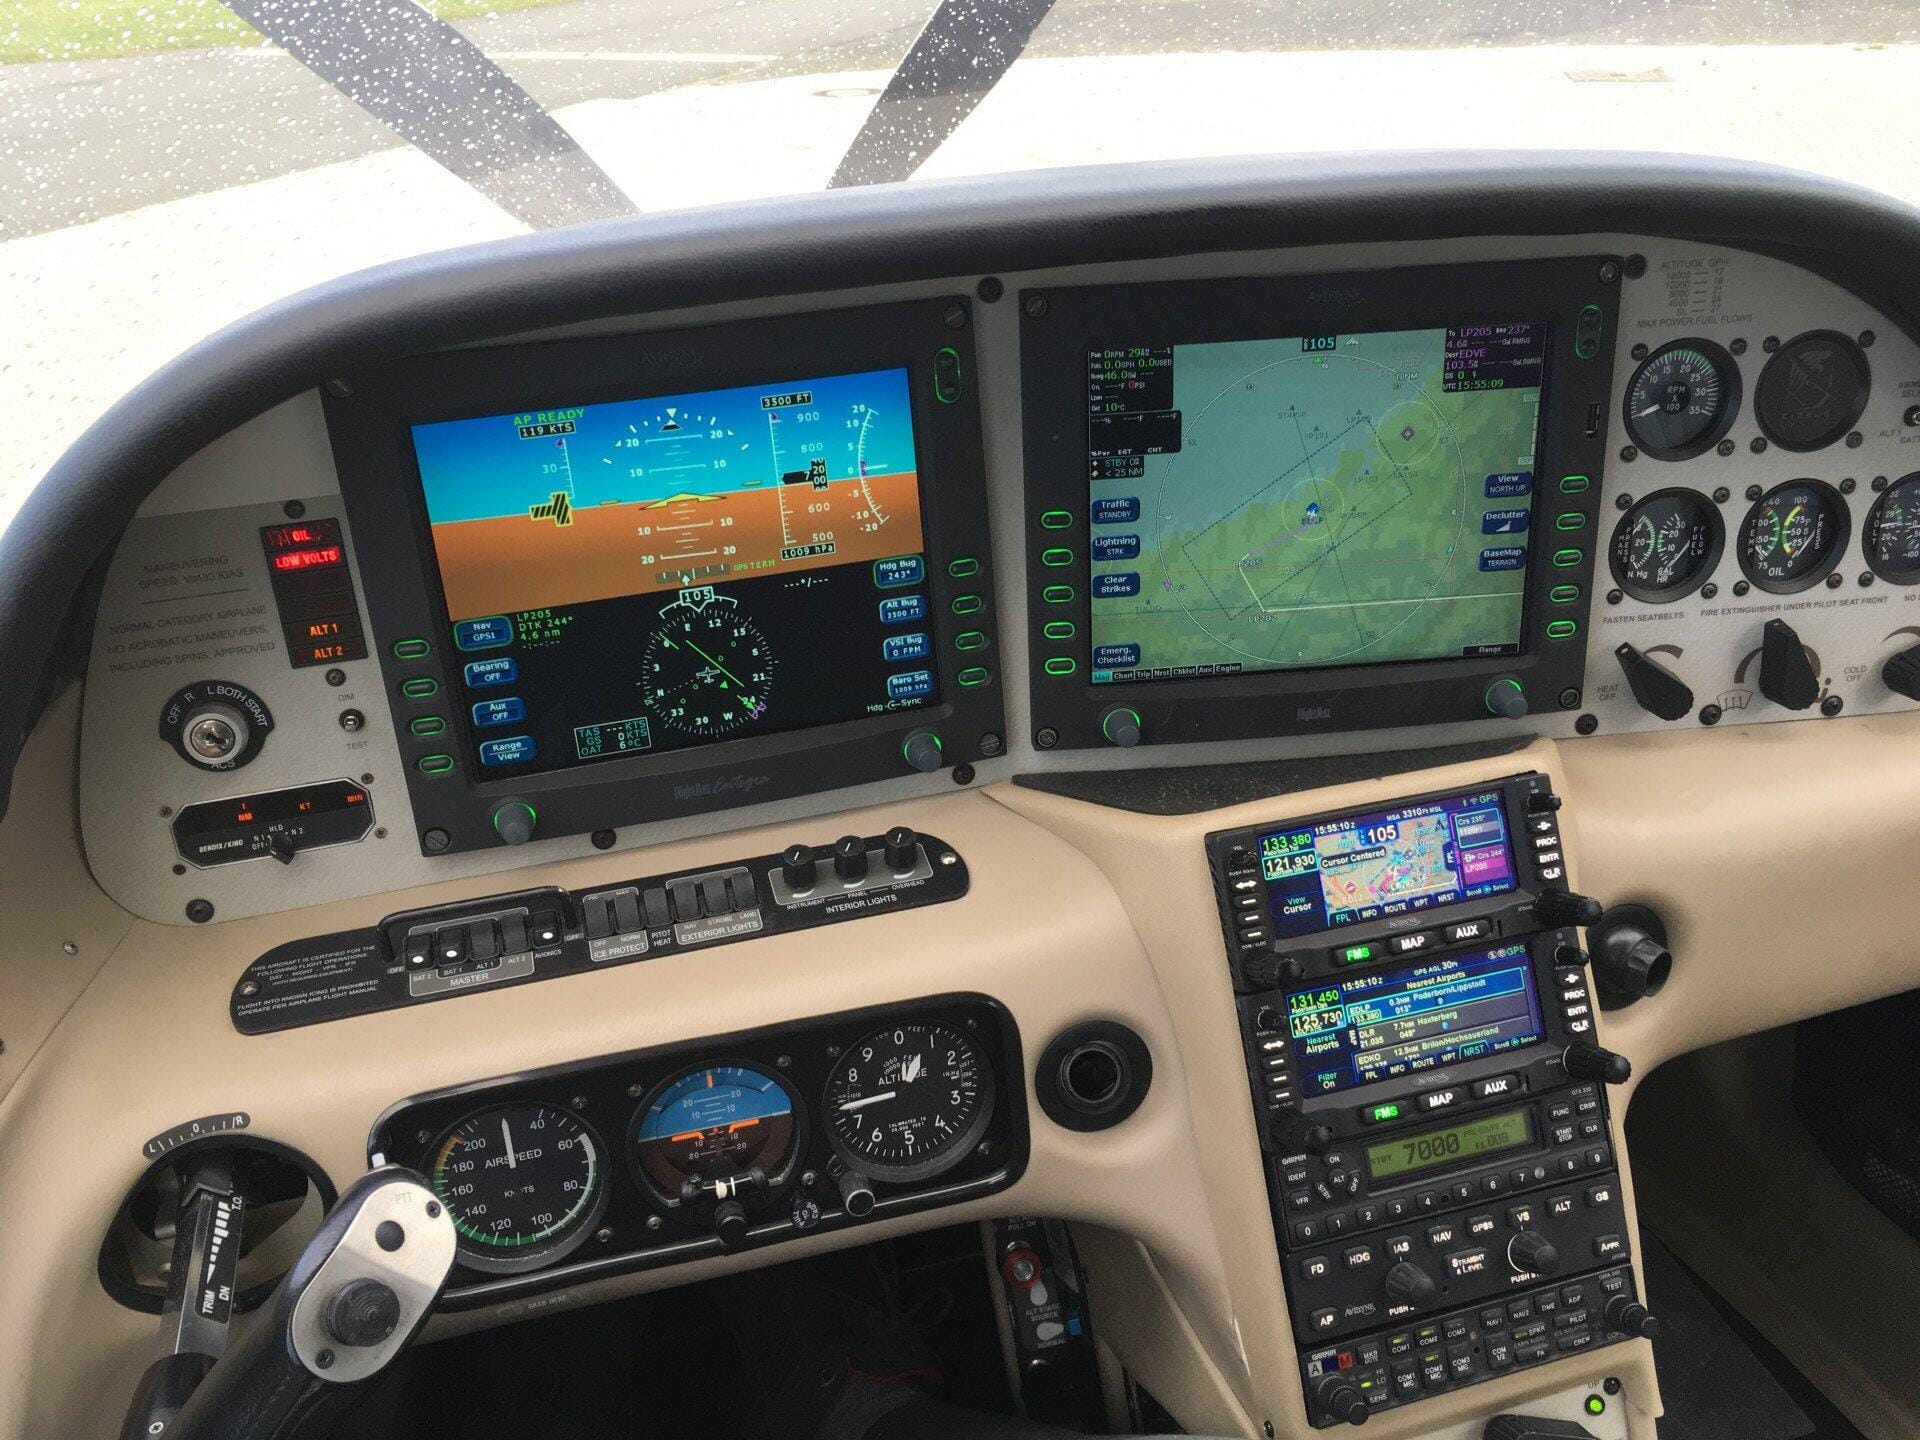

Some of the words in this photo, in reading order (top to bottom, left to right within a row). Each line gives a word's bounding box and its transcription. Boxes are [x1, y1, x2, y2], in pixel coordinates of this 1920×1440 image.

[1638, 320, 1656, 328] MAX
[1658, 318, 1693, 326] POWER
[1696, 316, 1718, 324] FUEL
[1721, 314, 1752, 323] FLOWS
[1461, 327, 1491, 337] LP205
[1310, 338, 1334, 348] 105
[1460, 349, 1486, 358] EDVE
[1458, 380, 1503, 390] 15:55:09
[764, 396, 791, 407] 3500
[796, 394, 810, 403] FT
[513, 416, 531, 426] AP
[538, 409, 585, 422] READY
[797, 412, 820, 422] 900
[521, 427, 544, 437] 119
[549, 423, 573, 433] KTS
[801, 442, 823, 453] 800
[808, 503, 830, 513] 600
[1101, 500, 1130, 508] Traffic
[1099, 511, 1131, 519] STANDBY
[1486, 512, 1525, 520] Declutter
[292, 531, 311, 542] OIL
[812, 532, 834, 542] 500
[1095, 537, 1136, 546] Lightning
[784, 547, 810, 559] 1009
[815, 544, 834, 553] hPa
[1484, 549, 1521, 557] BaseMap
[144, 555, 228, 573] MANEUVERING
[276, 555, 299, 569] LOW
[304, 550, 337, 564] VOLTS
[1769, 567, 1784, 576] OIL
[1104, 576, 1127, 584] Clear
[1101, 585, 1131, 593] Strikes
[684, 590, 710, 602] 105
[1701, 608, 1719, 616] FIRE
[1721, 603, 1781, 615] EXTINGUISHER
[1783, 602, 1811, 611] UNDER
[1814, 600, 1836, 609] PILOT
[1839, 598, 1859, 607] SEAT
[1861, 596, 1888, 606] FRONT
[110, 622, 155, 635] NORMAL
[157, 612, 213, 628] CATEGORY
[217, 605, 267, 619] AIRPLANE
[517, 610, 551, 621] LP205
[1603, 615, 1634, 624] FASTEN
[1637, 612, 1684, 622] SEATBELTS
[310, 624, 329, 636] ALT
[333, 623, 338, 633] 1
[473, 621, 491, 630] Nav
[473, 632, 495, 640] GPS1
[129, 636, 193, 652] ACROBATIC
[315, 649, 332, 659] ALT
[337, 646, 344, 656] 2
[1101, 647, 1132, 655] Emerg.
[110, 657, 172, 673] INCLUDING
[214, 642, 275, 657] APPROVED
[1098, 655, 1136, 664] Checklist
[473, 661, 509, 672] Bearing
[1114, 671, 1133, 679] Chart
[1136, 671, 1150, 679] Trip
[1216, 664, 1240, 672] Engine
[484, 673, 501, 682] OFF
[1597, 684, 1619, 694] HEAT
[1599, 693, 1616, 701] OFF
[167, 705, 182, 724] OFF
[217, 686, 246, 702] BOTH
[246, 699, 267, 728] START
[489, 702, 506, 711] Aux
[492, 712, 509, 721] OFF
[346, 740, 368, 750] TEST
[492, 741, 522, 752] Range
[498, 751, 520, 760] View
[1314, 823, 1349, 835] 15:55:10
[1368, 825, 1396, 843] 105
[199, 839, 243, 853] BENDIX/KING
[1263, 834, 1312, 850] 133.380
[1536, 837, 1557, 847] PROC
[1267, 854, 1315, 873] 121.930
[1322, 857, 1348, 867] Cursor
[1351, 850, 1385, 861] Centered
[848, 890, 867, 899] PANEL
[892, 880, 925, 891] OVERHEAD
[826, 900, 864, 914] INTERIOR
[866, 895, 897, 908] LIGHTS
[1284, 904, 1312, 914] Cursor
[1336, 914, 1351, 923] FPL
[1362, 909, 1377, 917] INFO
[1384, 903, 1406, 914] ROUTE
[1414, 899, 1427, 908] WPT
[1438, 893, 1455, 902] NRST
[652, 930, 671, 938] PITOT
[681, 928, 725, 941] EXTERIOR
[727, 921, 758, 934] LIGHTS
[1456, 926, 1479, 938] AUX
[654, 938, 672, 946] HEAT
[1401, 937, 1425, 950] MAP
[609, 943, 645, 955] PROTECT
[1347, 948, 1369, 961] FMS
[338, 980, 379, 991] PROHIBITED
[451, 973, 489, 986] MASTER
[1413, 979, 1486, 1001] Paderborn/Lippstadt
[238, 1007, 270, 1016] OPERATE
[349, 986, 377, 996] MANUAL
[1290, 990, 1339, 1008] 131.450
[1350, 1004, 1370, 1014] EDLP
[1417, 1011, 1458, 1026] Haxterberg
[894, 1031, 904, 1044] 0
[1307, 1034, 1335, 1045] Nearest
[1422, 1027, 1499, 1050] Brilon/Hochsauerland
[1306, 1040, 1339, 1054] Airports
[1464, 1046, 1484, 1056] NRST
[948, 1051, 956, 1065] 2
[849, 1068, 857, 1081] 8
[1484, 1081, 1507, 1094] AUX
[951, 1090, 960, 1105] 3
[1429, 1093, 1453, 1107] MAP
[1580, 1101, 1595, 1110] CRSR
[1553, 1108, 1569, 1116] FUNC
[530, 1119, 545, 1130] 40
[905, 1130, 914, 1144] 5
[463, 1138, 486, 1151] 200
[558, 1139, 572, 1150] 60
[1403, 1134, 1459, 1164] 7000
[1282, 1155, 1306, 1164] GARMIN
[452, 1161, 474, 1173] 180
[1288, 1172, 1306, 1181] IDENT
[452, 1184, 473, 1196] 160
[563, 1180, 578, 1191] 80
[465, 1204, 487, 1217] 140
[1555, 1201, 1571, 1212] ALT
[490, 1218, 512, 1231] 120
[531, 1213, 552, 1226] 100
[1433, 1232, 1451, 1242] NAV
[1350, 1252, 1371, 1265] HDG
[1606, 1282, 1622, 1291] TEST
[202, 1290, 215, 1314] TRIM
[1321, 1315, 1333, 1326] AP
[1570, 1314, 1587, 1323] PILOT
[1392, 1344, 1409, 1353] COM1
